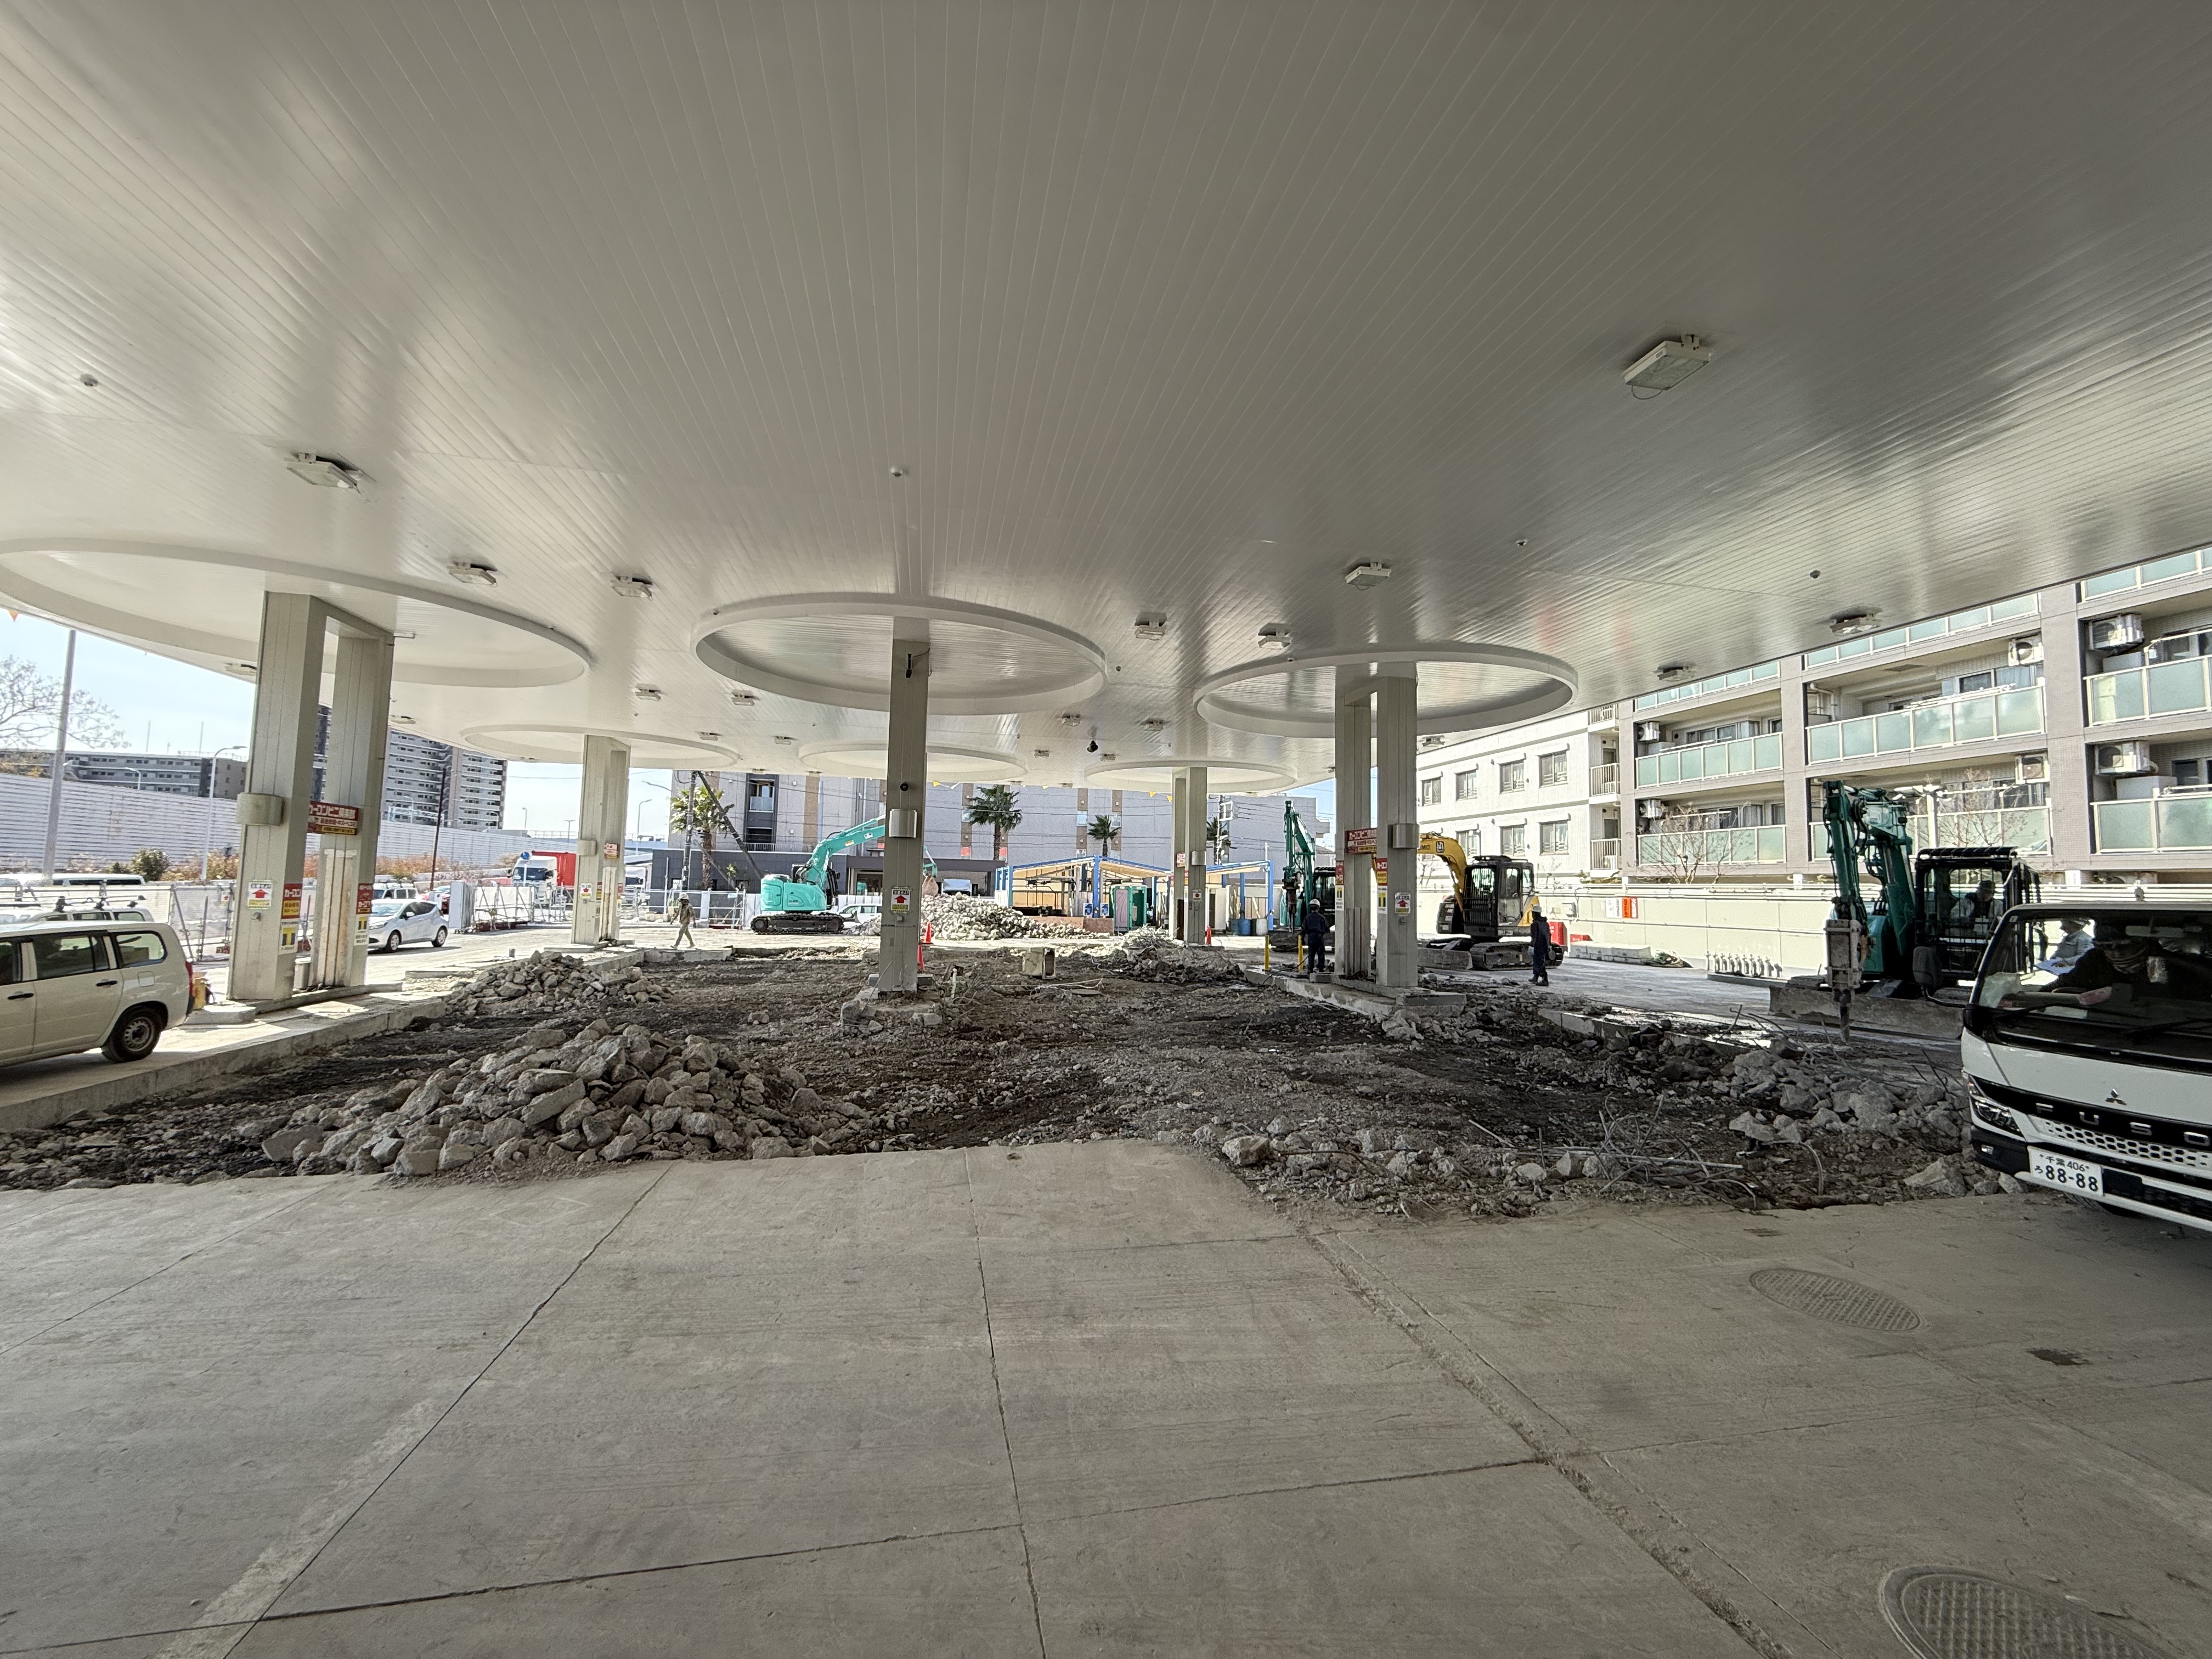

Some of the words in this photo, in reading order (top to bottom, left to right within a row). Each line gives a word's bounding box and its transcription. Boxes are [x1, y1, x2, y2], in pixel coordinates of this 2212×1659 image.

[284, 889, 301, 898] カーコン
[2035, 1103, 2210, 1146] FUSO
[2045, 1165, 2098, 1192] 88-88
